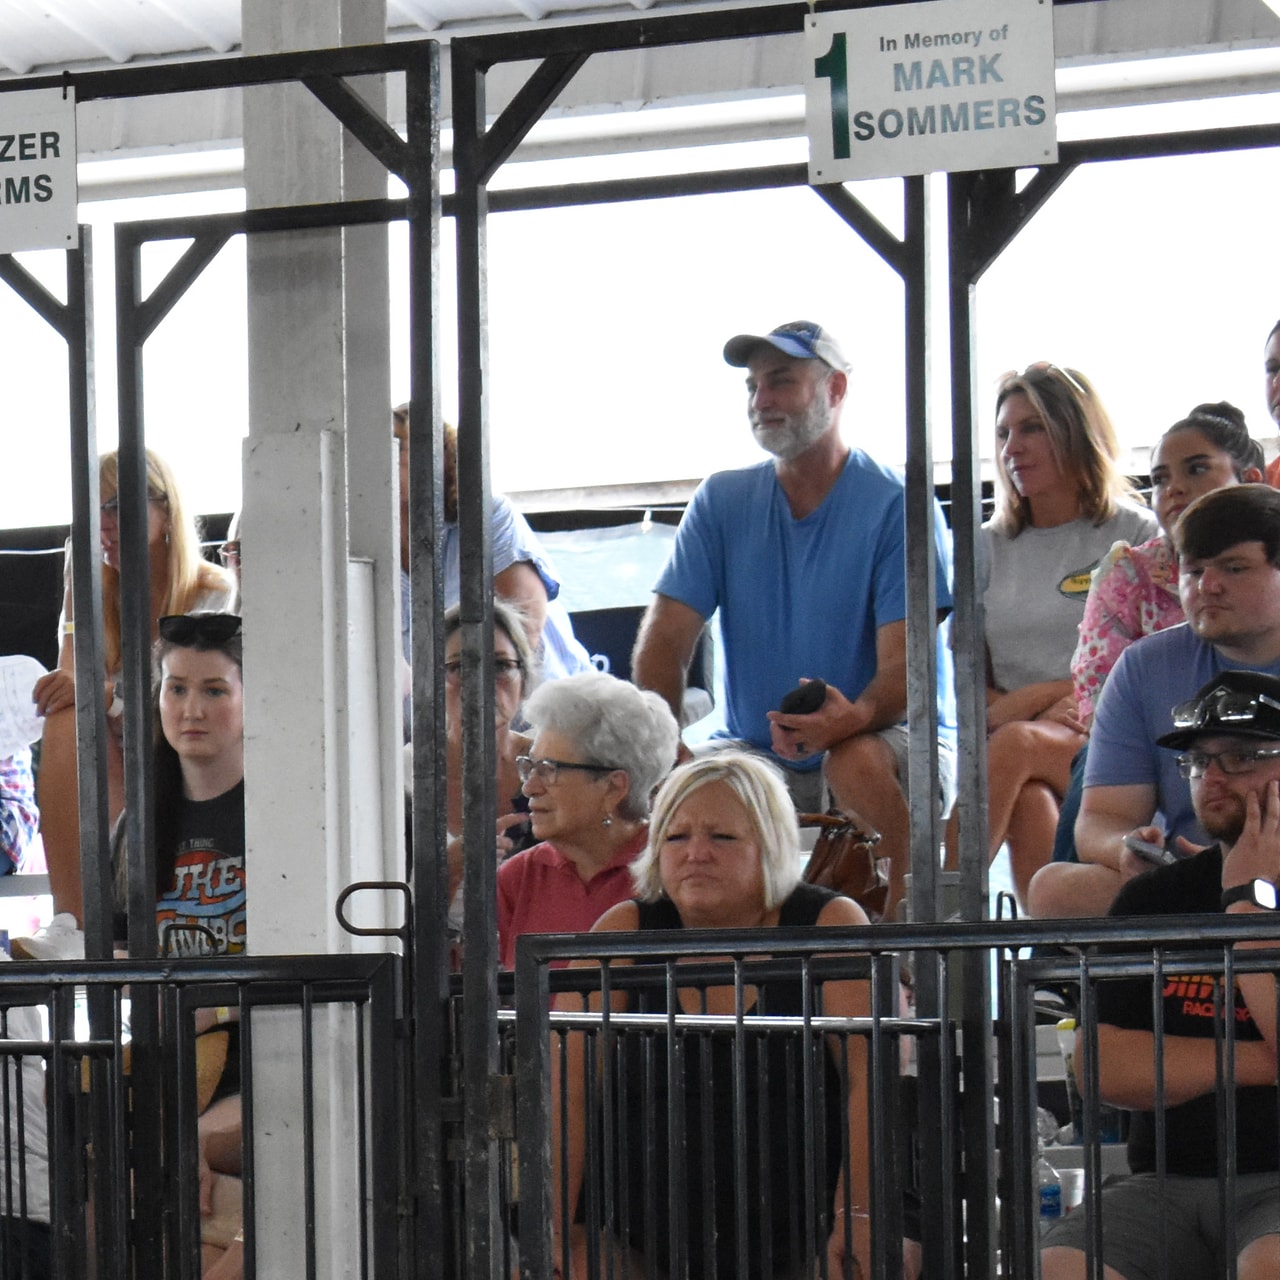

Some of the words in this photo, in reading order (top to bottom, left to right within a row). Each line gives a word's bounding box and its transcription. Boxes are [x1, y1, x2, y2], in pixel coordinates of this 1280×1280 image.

[880, 36, 897, 52] In
[904, 30, 982, 50] Memory
[989, 24, 1009, 41] of
[893, 53, 1004, 92] MARK
[815, 32, 851, 159] 1
[853, 95, 1046, 141] SOMMERS
